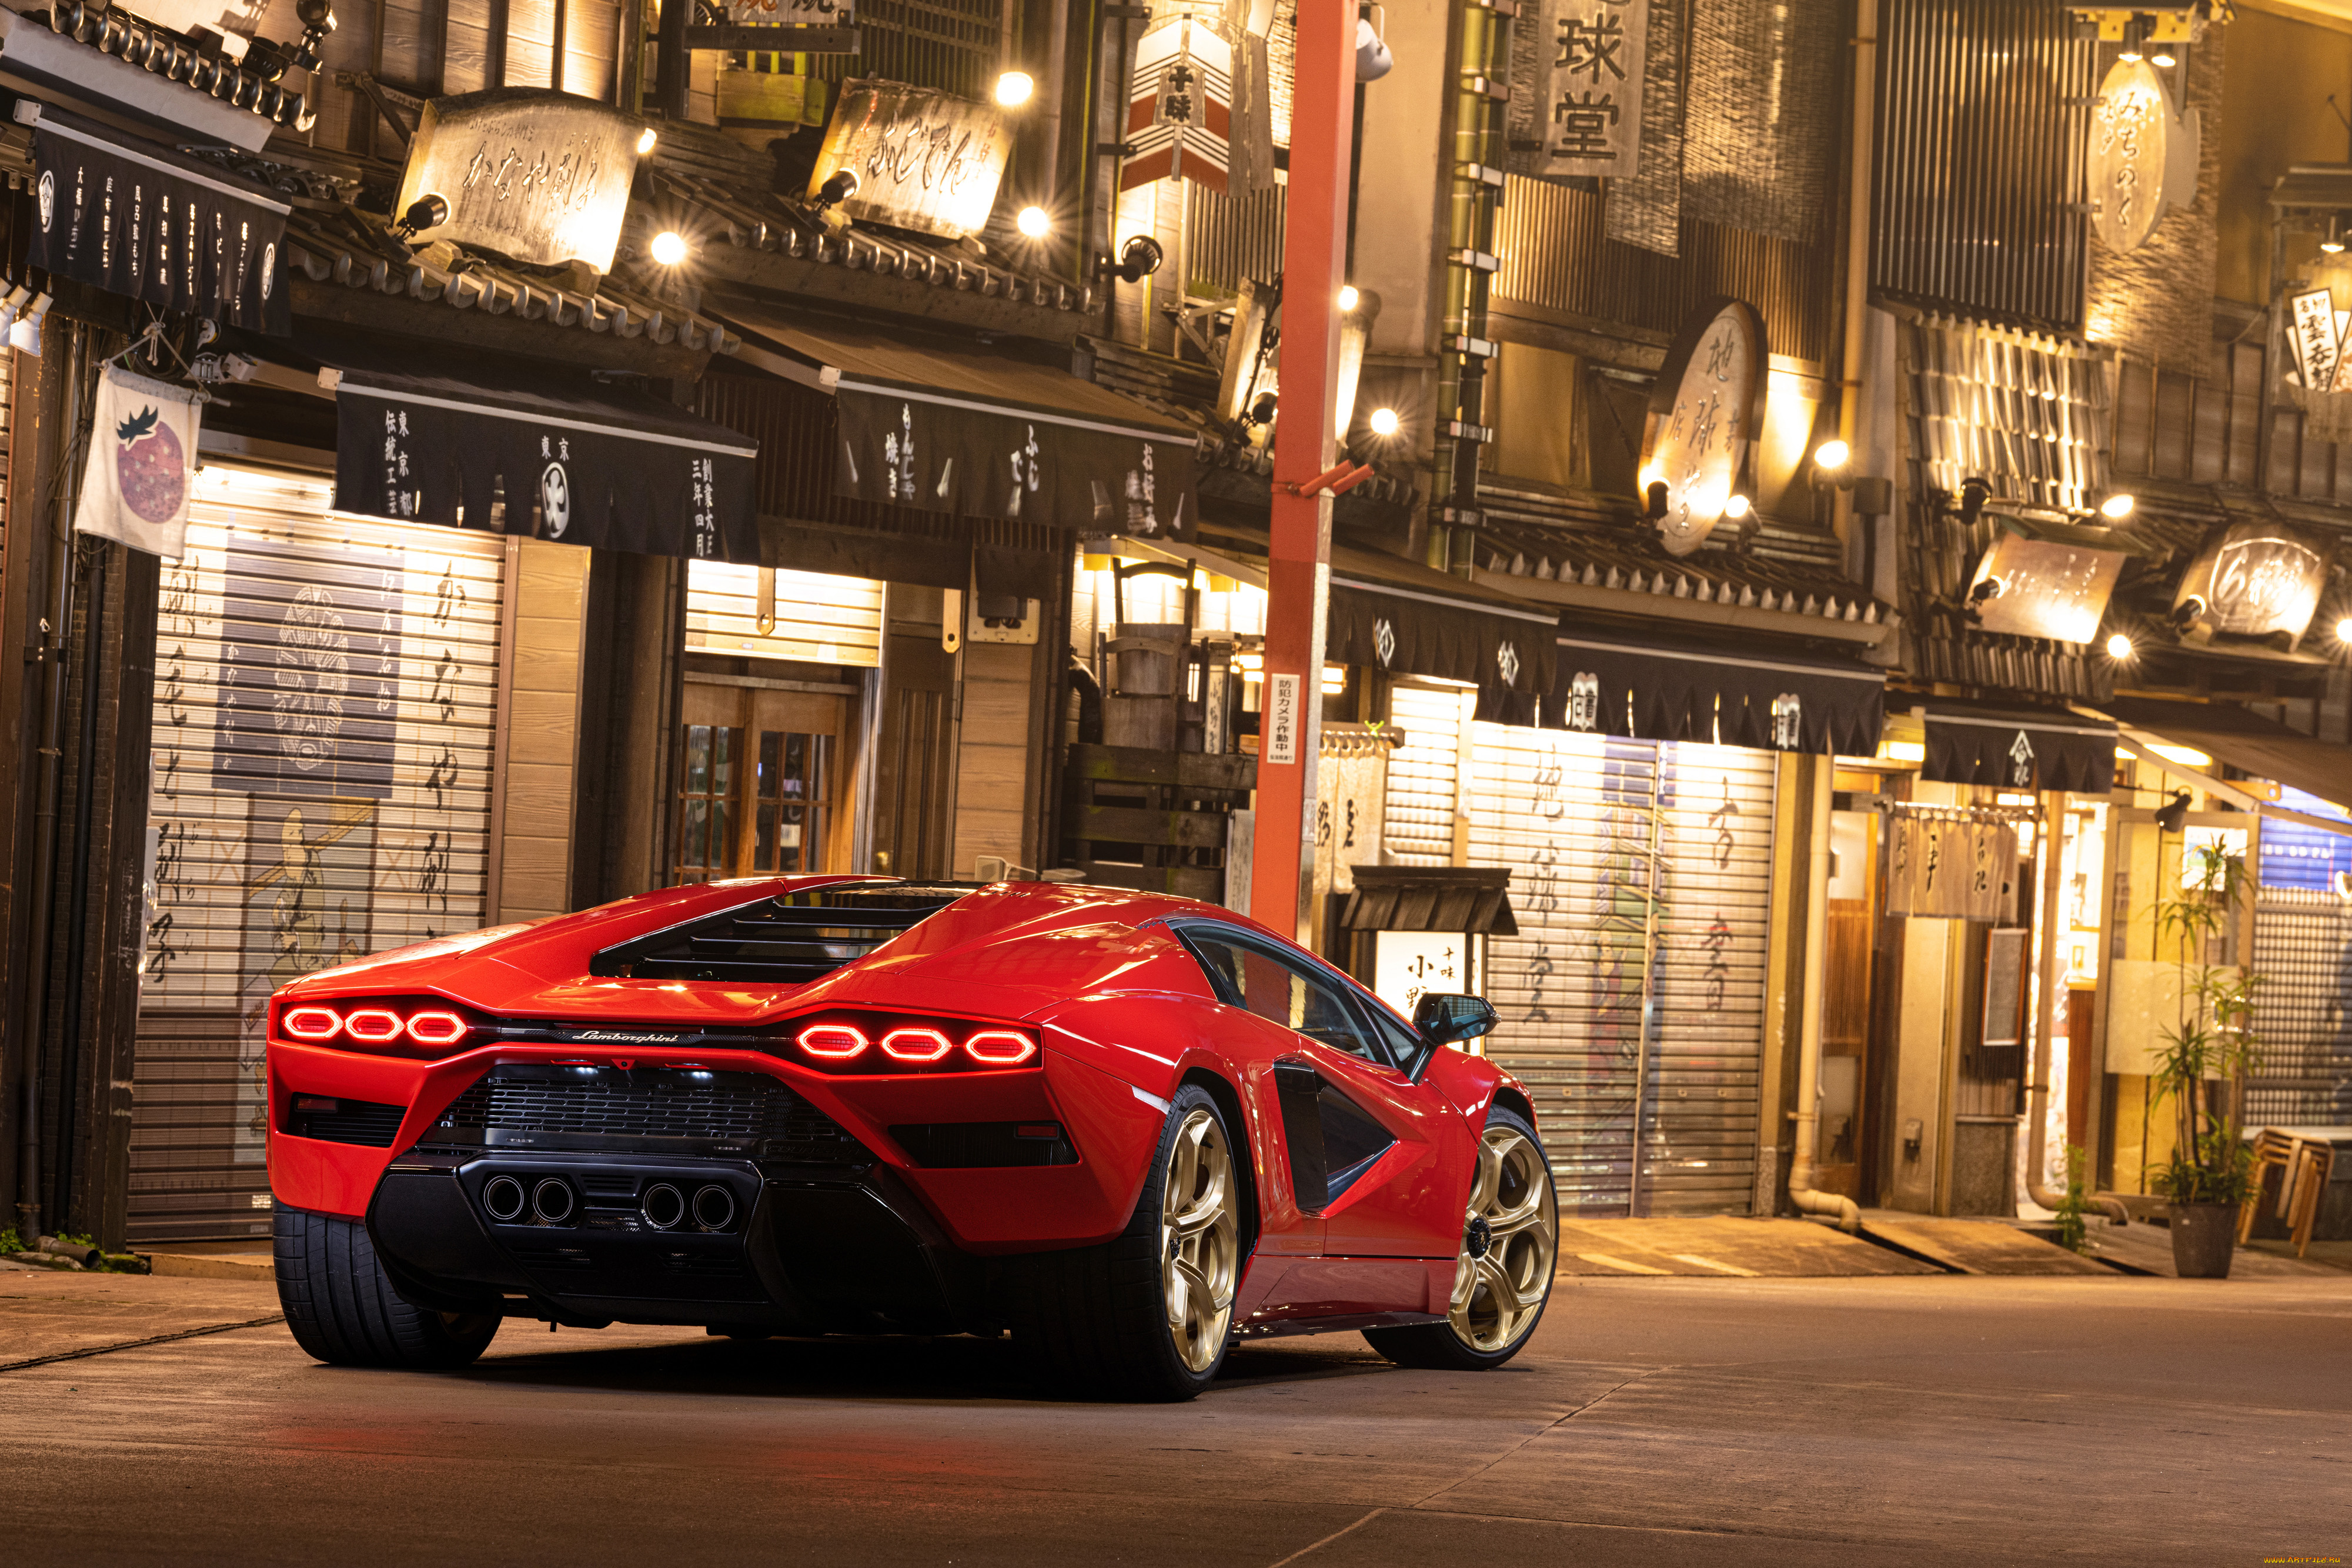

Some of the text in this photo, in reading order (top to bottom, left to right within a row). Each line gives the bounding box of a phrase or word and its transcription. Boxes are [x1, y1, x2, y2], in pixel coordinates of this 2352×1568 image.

[1550, 0, 1626, 160] 球堂
[462, 140, 599, 215] かなや刷子
[2119, 92, 2142, 229] みちのく
[385, 409, 397, 515] 伝統工芸
[398, 410, 413, 516] 東京都
[540, 435, 570, 462] 東京
[692, 460, 704, 557] 三年四月
[421, 559, 467, 942] かなや刷
[1275, 680, 1292, 751] 防犯カメラ作動中
[1441, 947, 1456, 979] 十味
[572, 1031, 678, 1043] Lamborghini
